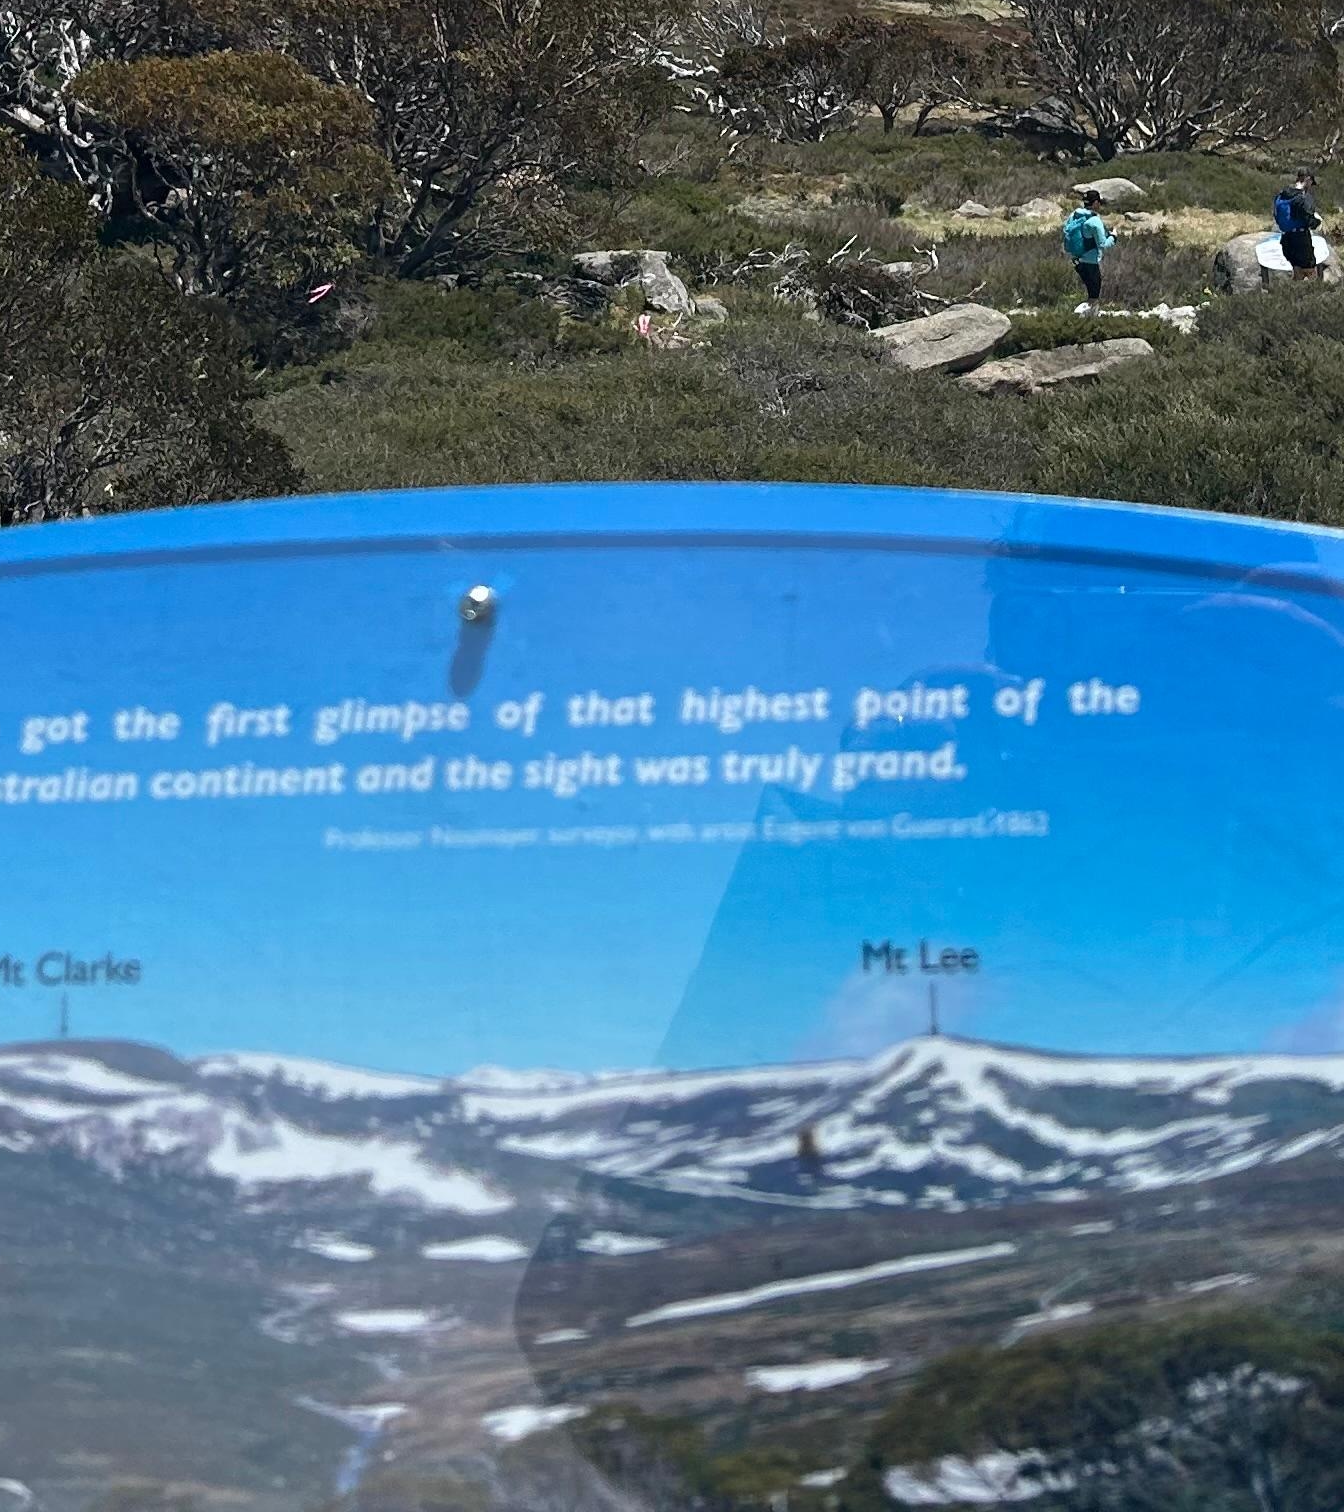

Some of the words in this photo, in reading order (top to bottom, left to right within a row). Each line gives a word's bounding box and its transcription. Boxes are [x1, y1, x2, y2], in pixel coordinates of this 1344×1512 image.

[19, 711, 90, 755] got
[113, 705, 181, 740] the
[207, 701, 291, 745] first
[314, 698, 470, 745] glimpse
[495, 692, 544, 737] of
[568, 691, 655, 726] that
[680, 687, 830, 733] highest
[856, 682, 969, 728] point
[994, 678, 1045, 724] of
[1068, 678, 1140, 714] the
[151, 762, 346, 798] continent
[356, 757, 434, 791] and
[444, 755, 513, 788] the
[525, 752, 620, 797] sight
[635, 755, 709, 786] was
[723, 746, 819, 791] truly
[830, 742, 967, 791] grand.
[36, 950, 142, 986] Clarke
[862, 939, 907, 975] Mt
[919, 938, 980, 974] Lee
